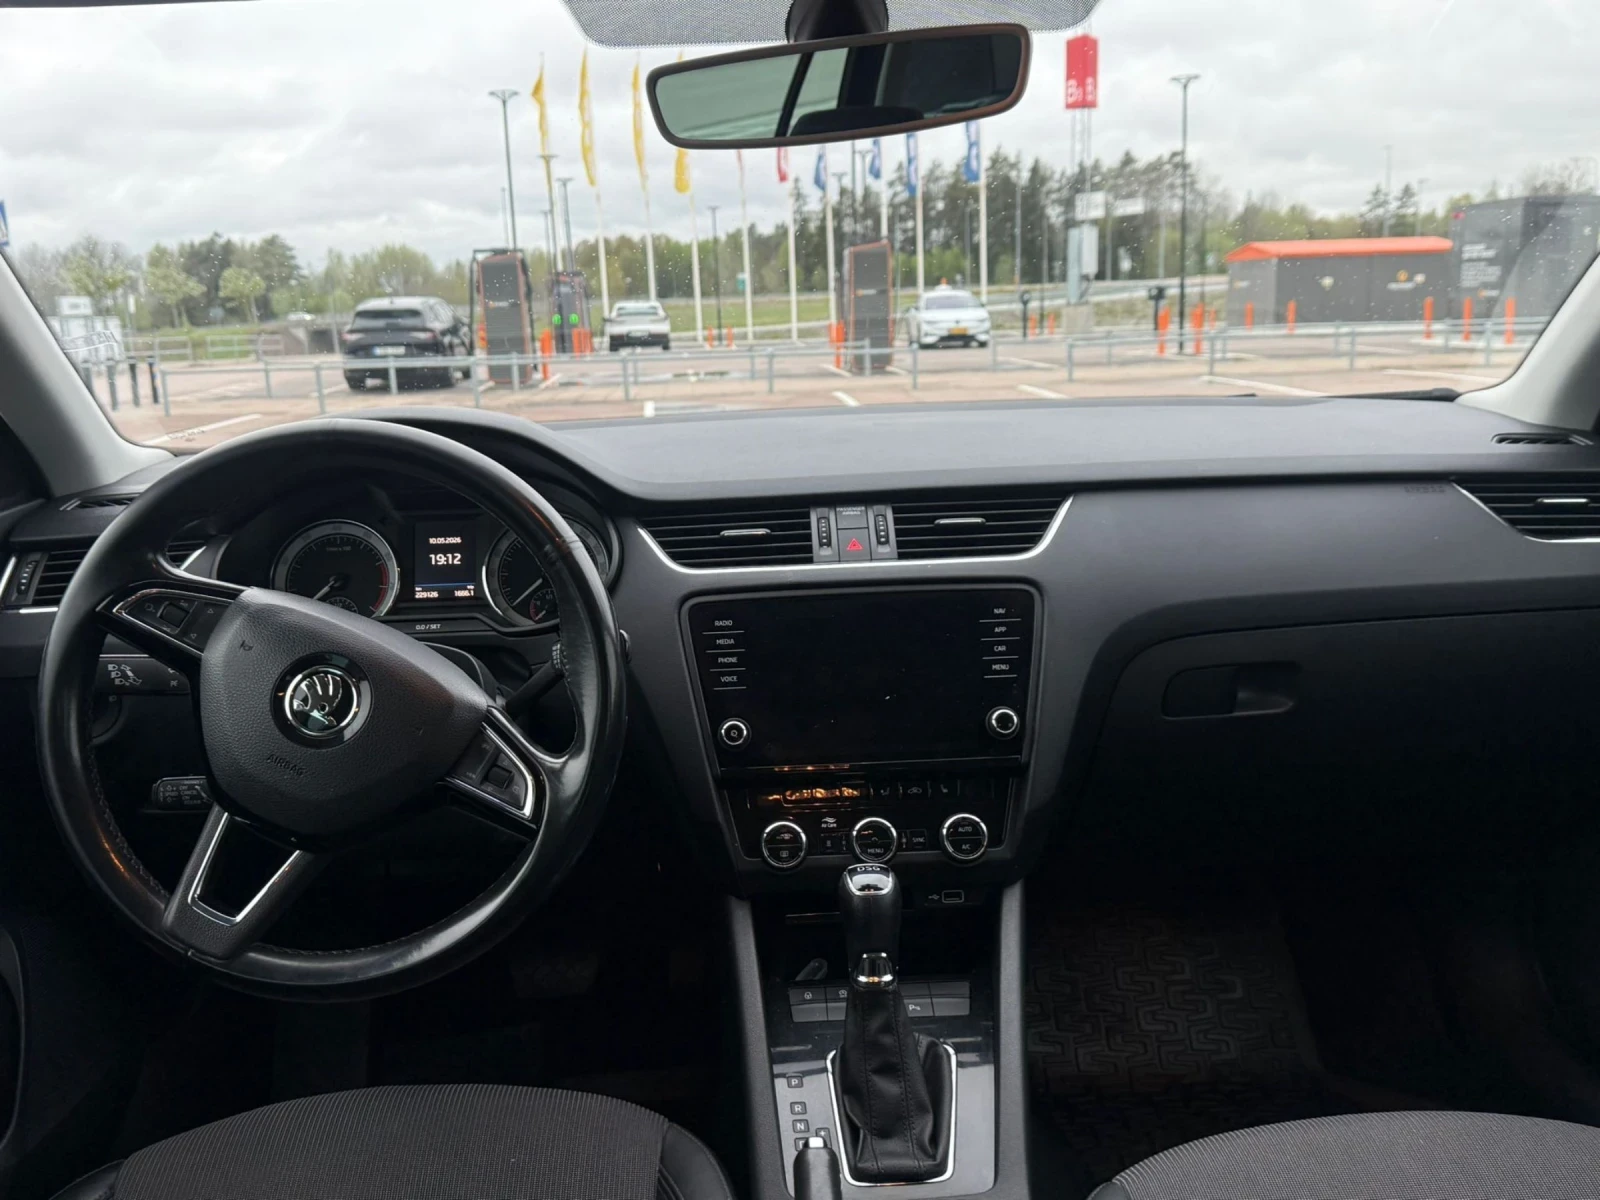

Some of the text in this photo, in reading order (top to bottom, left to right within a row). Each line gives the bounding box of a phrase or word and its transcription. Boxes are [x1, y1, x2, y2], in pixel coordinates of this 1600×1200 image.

[429, 553, 462, 565] 19:12
[266, 754, 307, 777] AIRBAG
[796, 1122, 805, 1130] N
